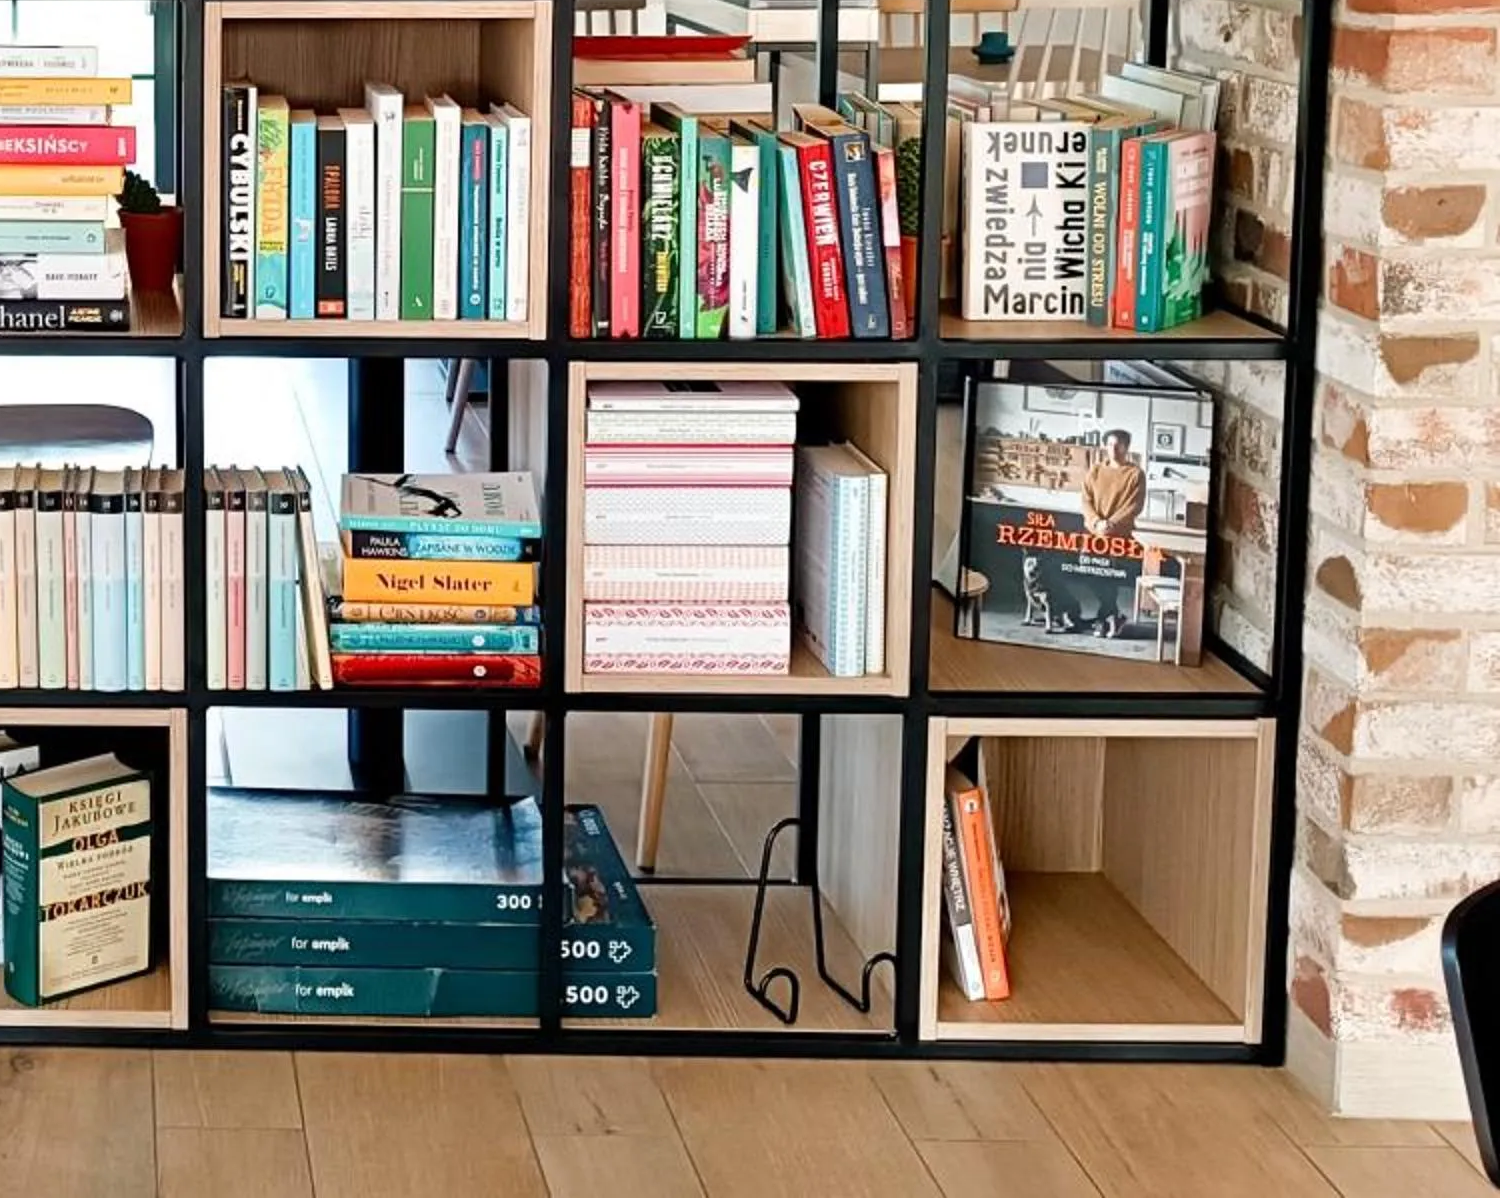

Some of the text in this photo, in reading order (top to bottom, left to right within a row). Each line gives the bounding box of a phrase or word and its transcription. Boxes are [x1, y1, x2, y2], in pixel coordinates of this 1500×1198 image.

[229, 132, 250, 261] CYBULSKI
[1054, 200, 1085, 280] Wicha
[1091, 181, 1108, 307] WOLNI OD STRESU
[984, 283, 1085, 314] Marcin
[1026, 511, 1056, 527] SIŁA
[369, 535, 401, 547] PAULA
[415, 541, 460, 554] ZAPISANE
[996, 524, 1168, 563] RZEMIOSŁA
[362, 546, 408, 558] HAWKINS
[376, 571, 493, 592] Nigel Slater
[68, 790, 123, 814] KSIĘGI
[52, 802, 137, 836] JAKUBOWE
[71, 829, 121, 853] OLGA
[40, 881, 150, 922] TOKARCZUK
[285, 892, 333, 905] for empik
[496, 894, 532, 910] 300
[291, 936, 351, 953] for empik
[560, 940, 601, 959] 500
[294, 983, 355, 1000] for empik
[565, 986, 609, 1004] 500
